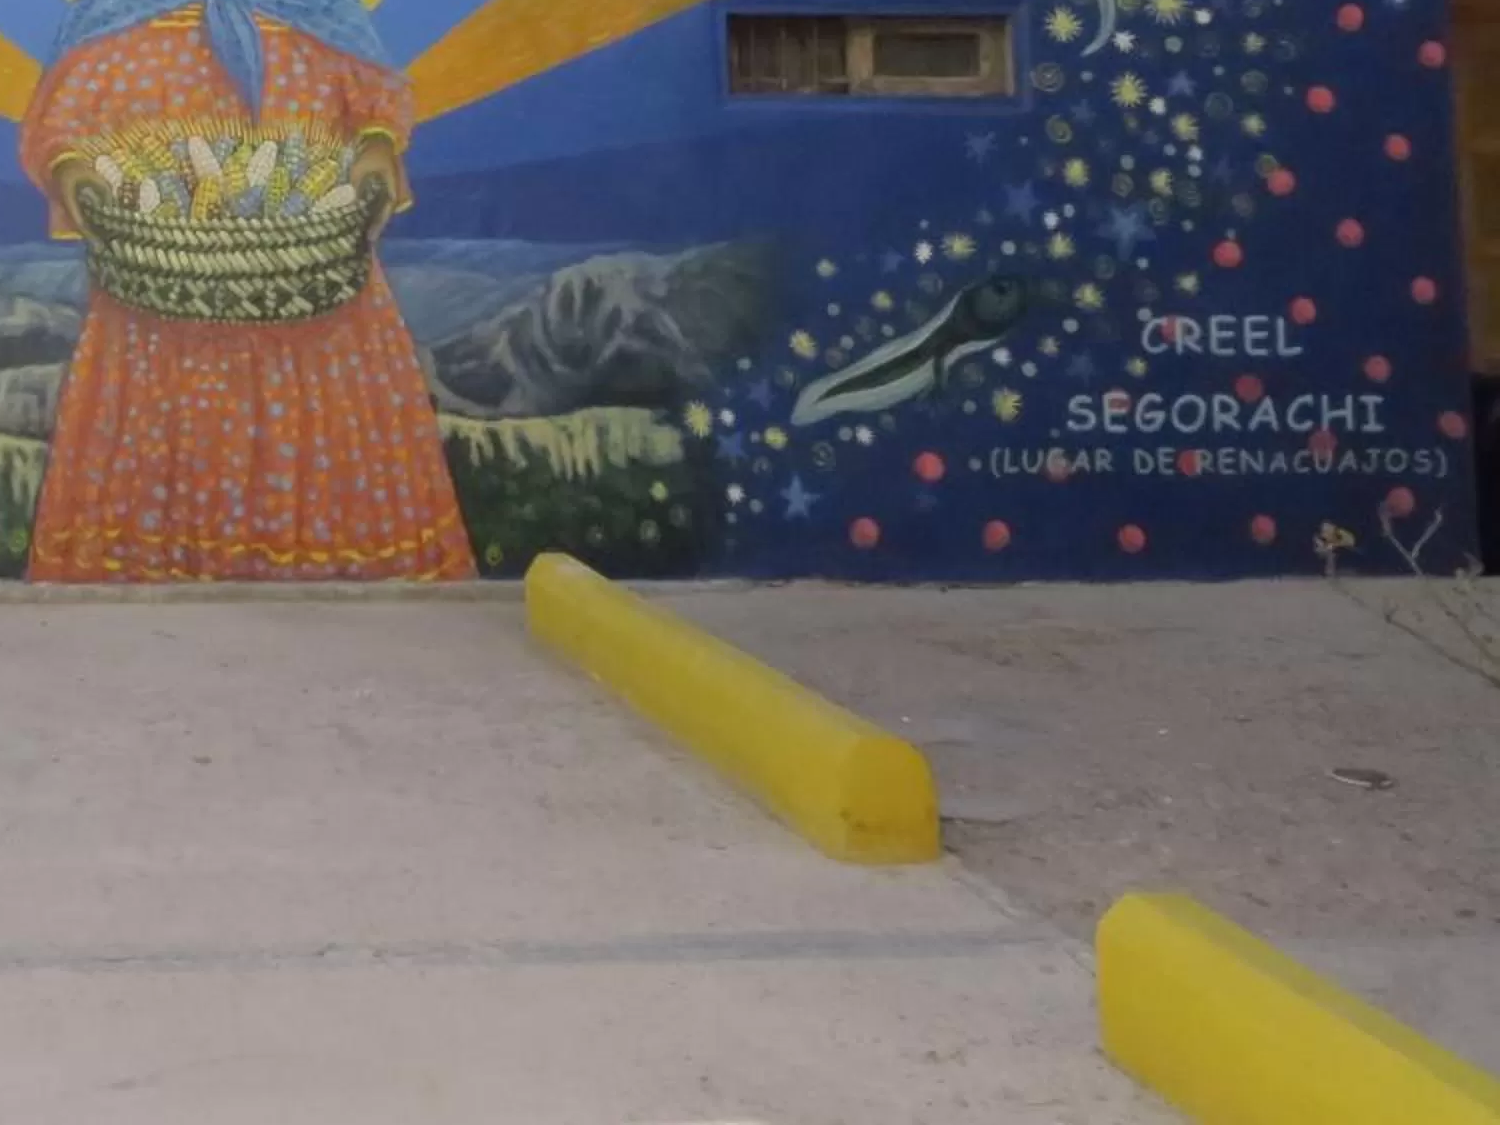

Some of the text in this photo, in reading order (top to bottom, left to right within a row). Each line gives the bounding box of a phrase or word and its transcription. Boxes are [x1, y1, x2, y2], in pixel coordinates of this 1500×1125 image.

[1141, 315, 1304, 355] CREEL
[1066, 394, 1385, 433] SEGORACHI
[990, 447, 1448, 477] (LUGAR DE RENACUAJOS)
